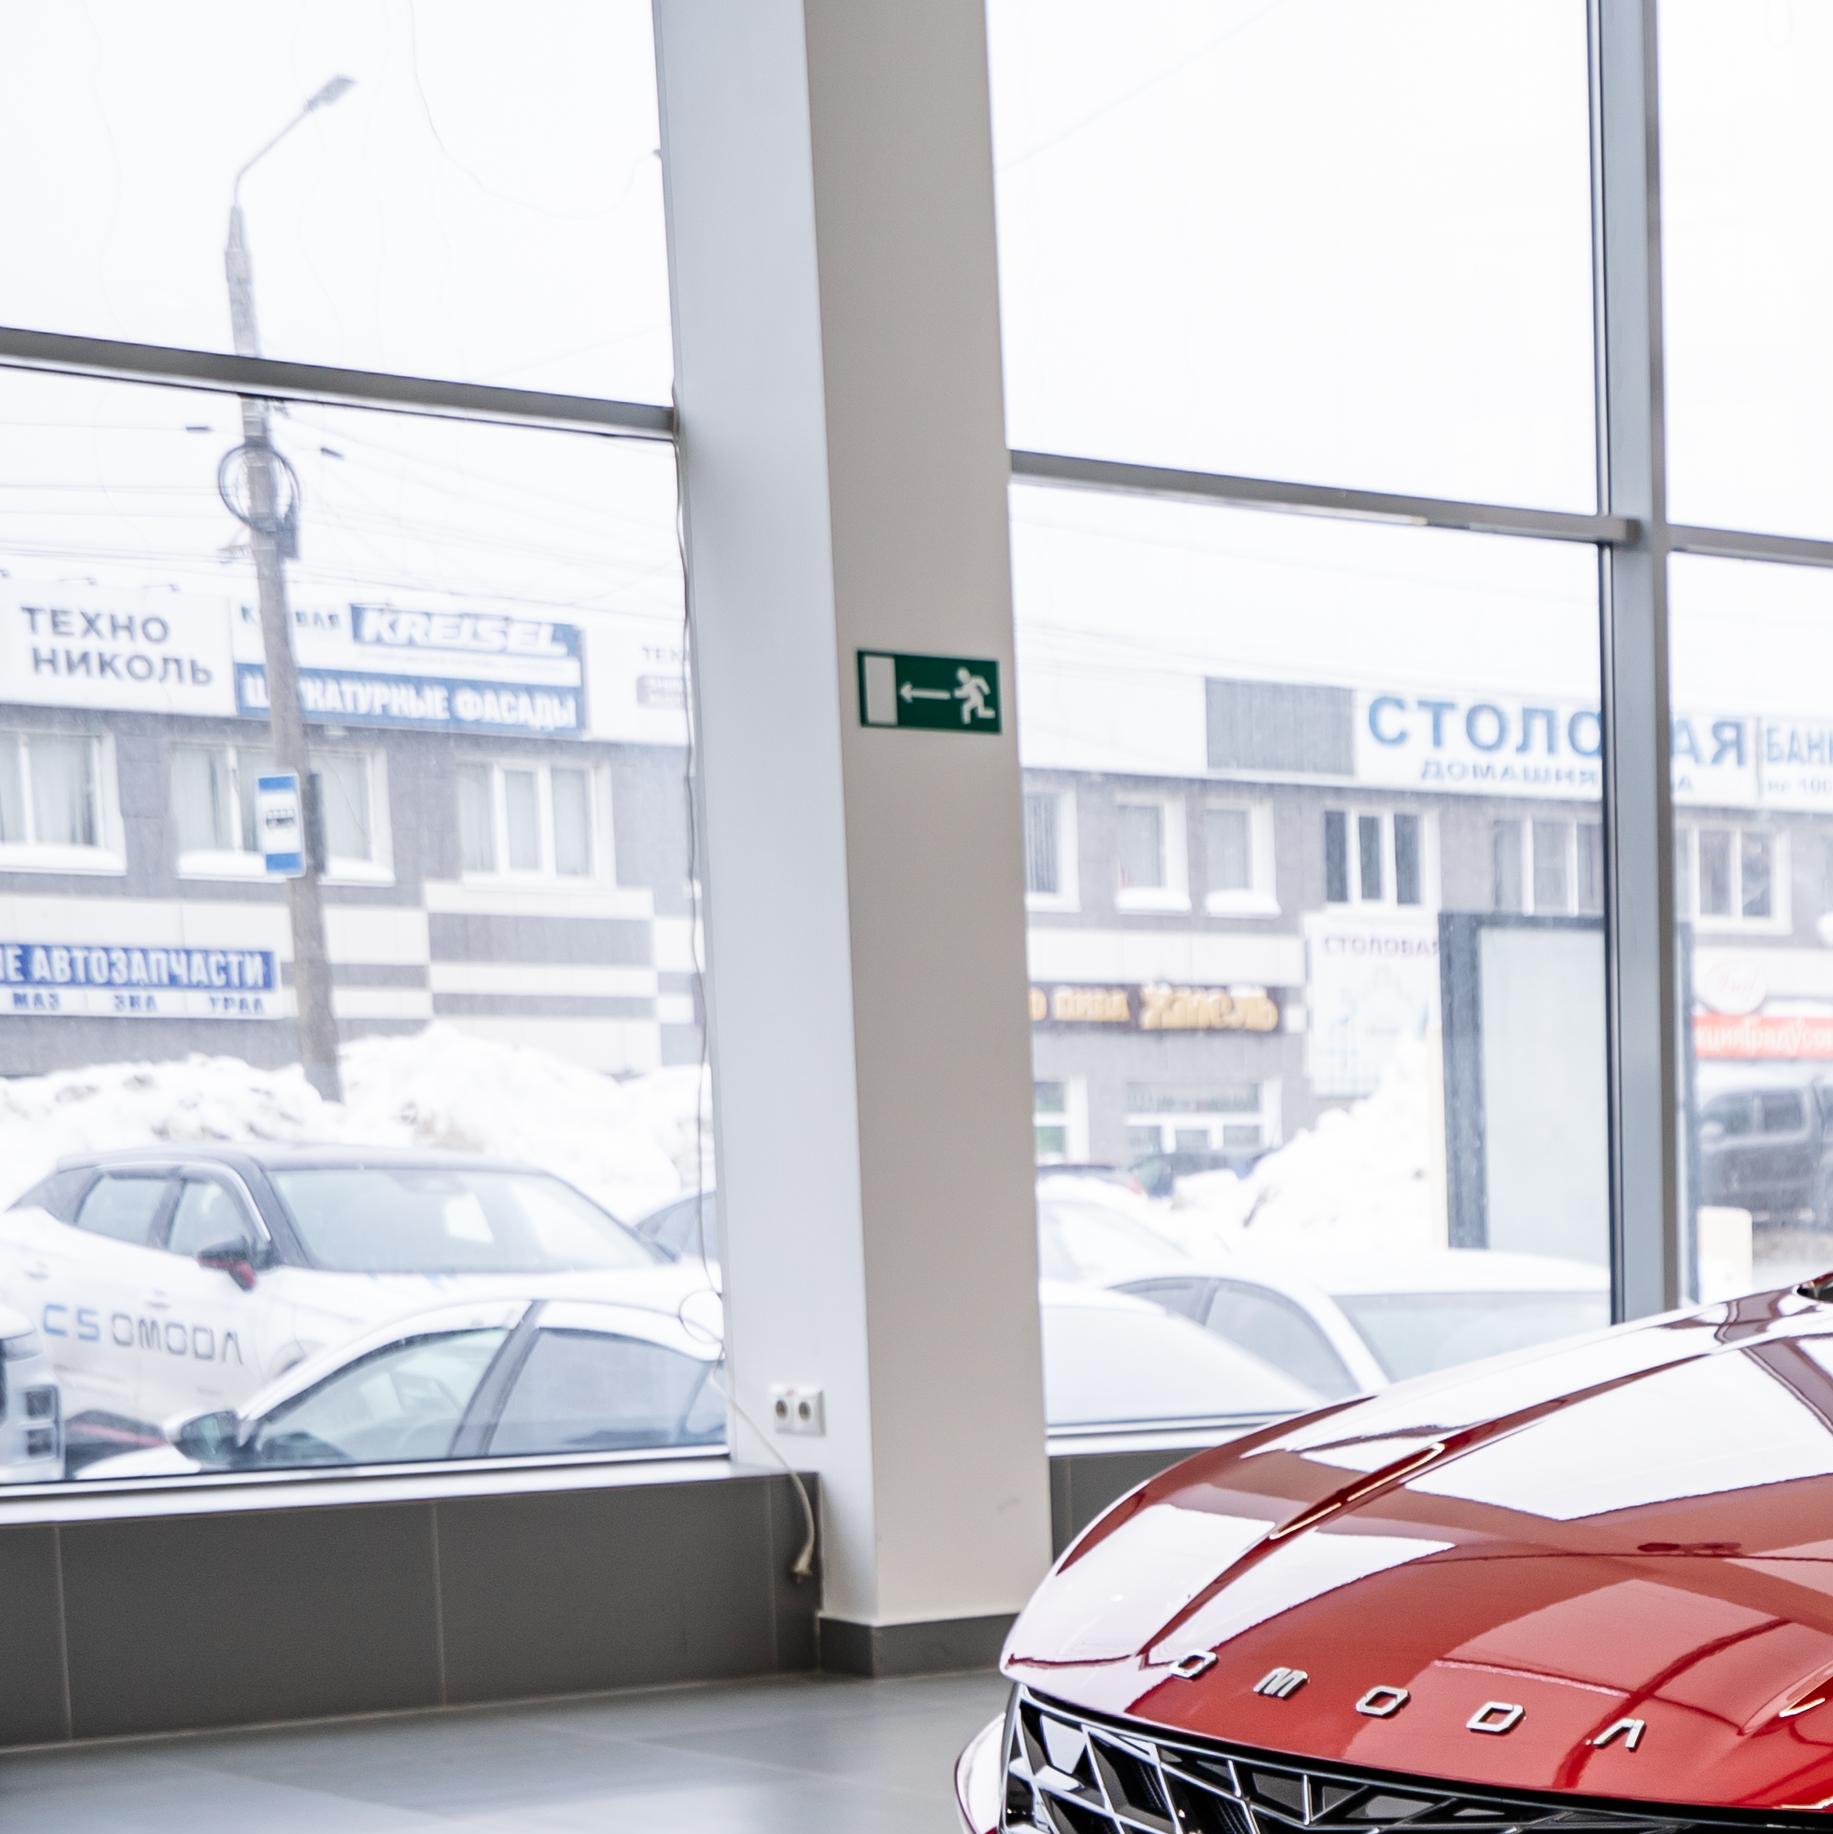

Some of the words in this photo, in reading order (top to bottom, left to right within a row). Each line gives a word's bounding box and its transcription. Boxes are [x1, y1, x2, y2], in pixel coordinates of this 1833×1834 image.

[21, 605, 169, 643] ТЕХНО
[358, 607, 568, 656] KREISEL
[31, 647, 213, 686] НИКОЛЬ
[243, 674, 450, 720] ШКАТУРНЫЕ
[454, 686, 577, 731] ФАСАДЫ
[1368, 697, 1745, 767] СТОЛОАЯ
[31, 947, 264, 988] АВТОЗАПЧАСТИ
[111, 1313, 244, 1366] OMODA
[1168, 1649, 1647, 1752] OMODA
